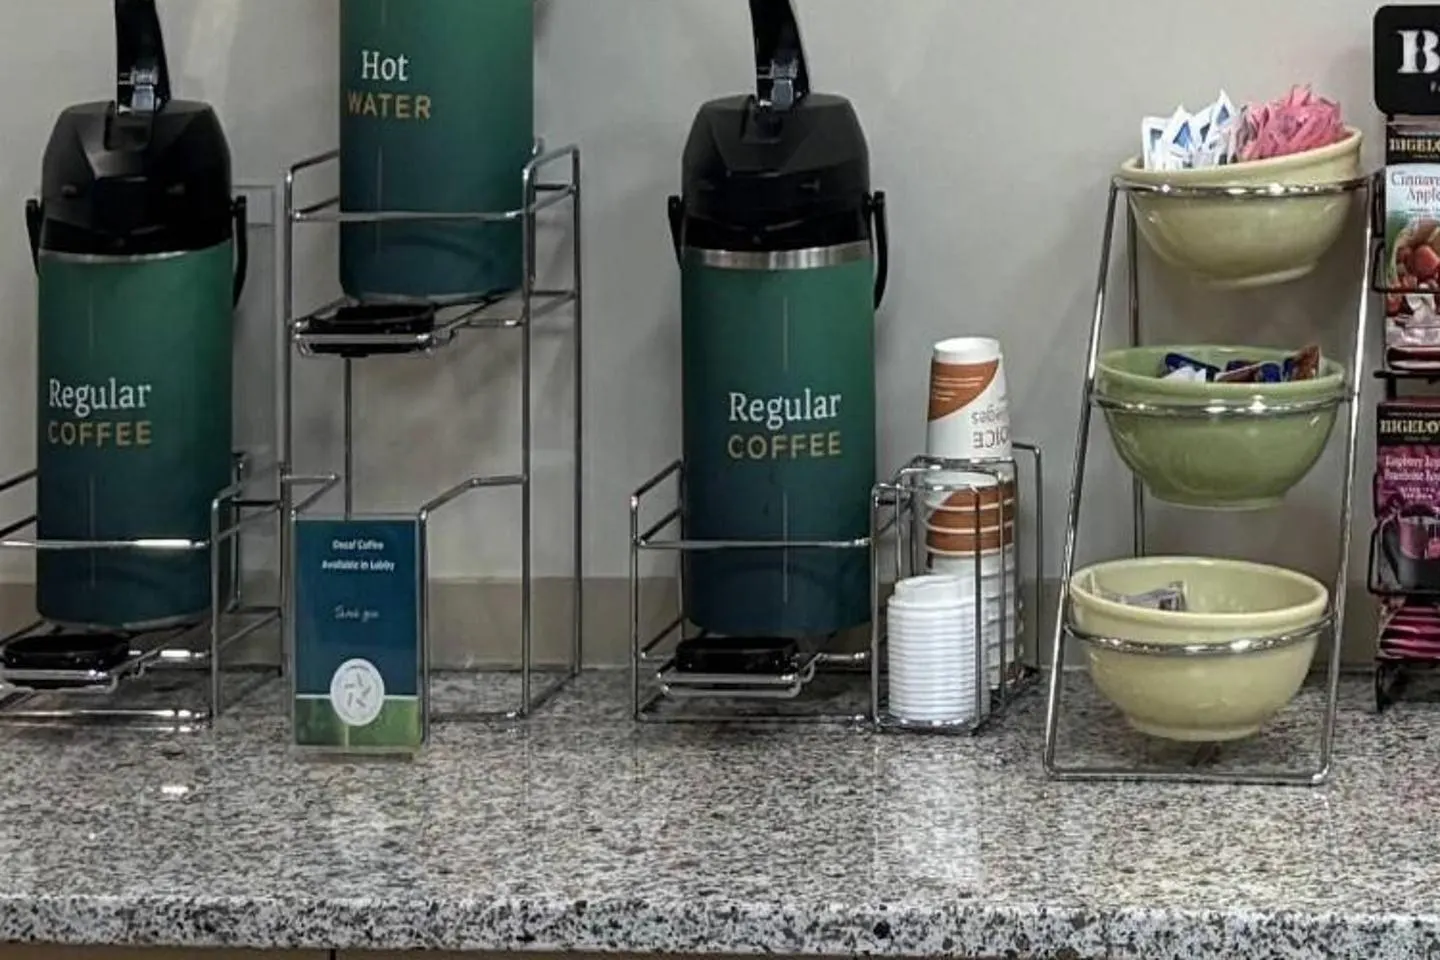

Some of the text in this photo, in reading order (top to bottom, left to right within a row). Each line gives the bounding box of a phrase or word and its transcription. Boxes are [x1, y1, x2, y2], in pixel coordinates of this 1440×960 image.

[361, 49, 409, 81] Hot
[347, 90, 432, 119] WATER
[49, 377, 152, 418] Regular
[728, 387, 842, 430] Regular
[47, 421, 153, 447] COFFEE
[727, 431, 842, 459] COFFEE
[357, 539, 385, 550] Coffee
[322, 559, 360, 570] Available
[370, 560, 395, 573] Lobby
